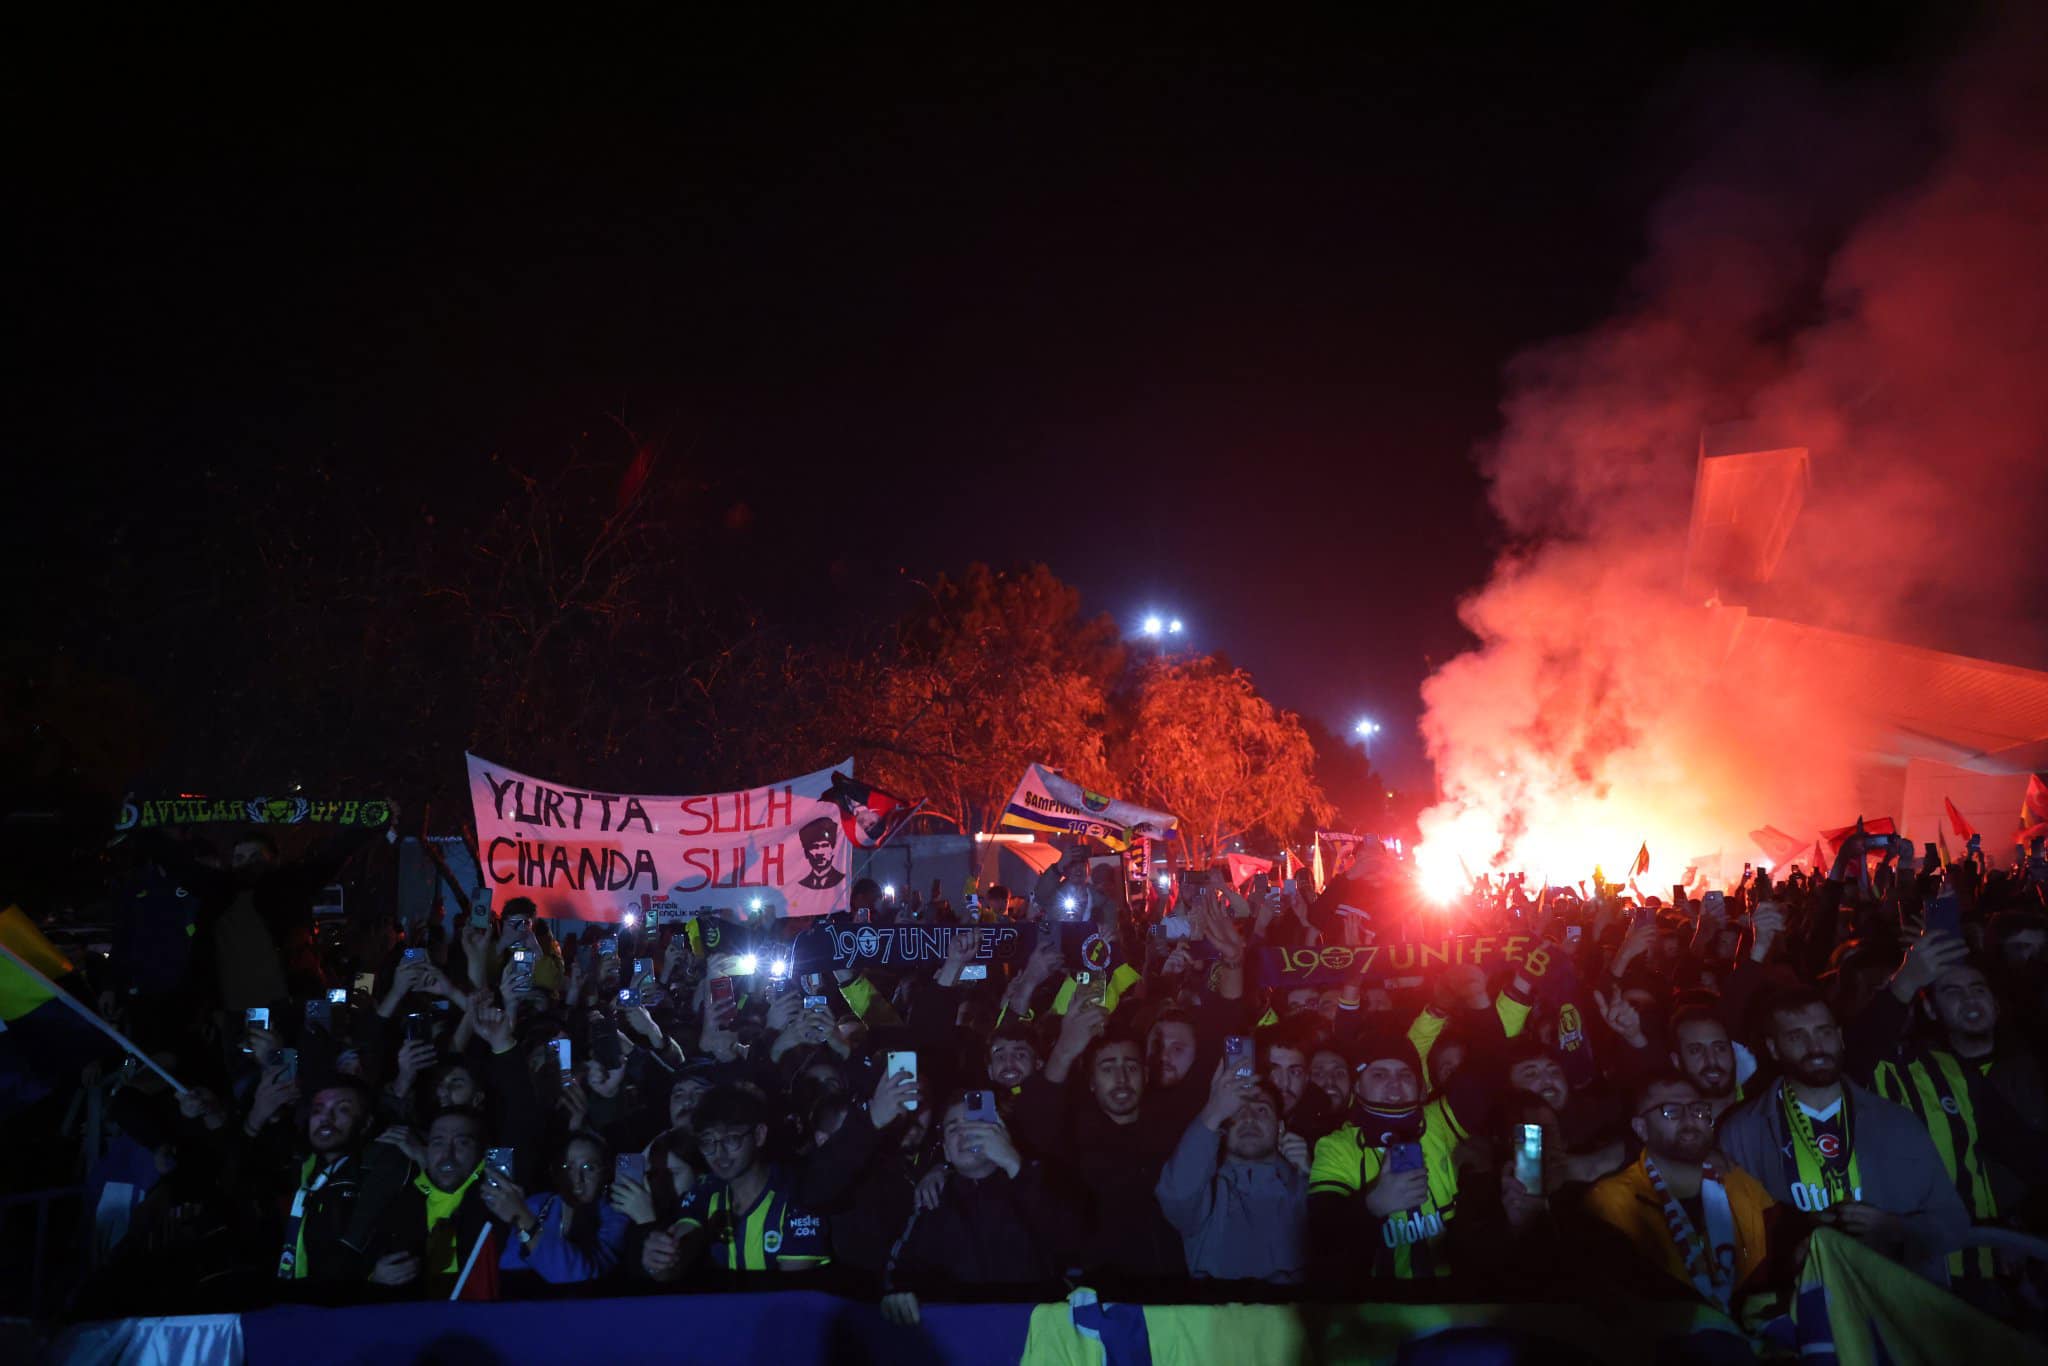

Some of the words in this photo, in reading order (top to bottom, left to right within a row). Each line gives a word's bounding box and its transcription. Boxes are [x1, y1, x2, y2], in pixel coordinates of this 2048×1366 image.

[484, 772, 653, 834] YURTTA
[679, 785, 792, 836] SULH
[488, 832, 659, 891] CİHANDA
[674, 844, 784, 893] SULH
[825, 924, 895, 968] 1907
[1280, 946, 1379, 978] 1907
